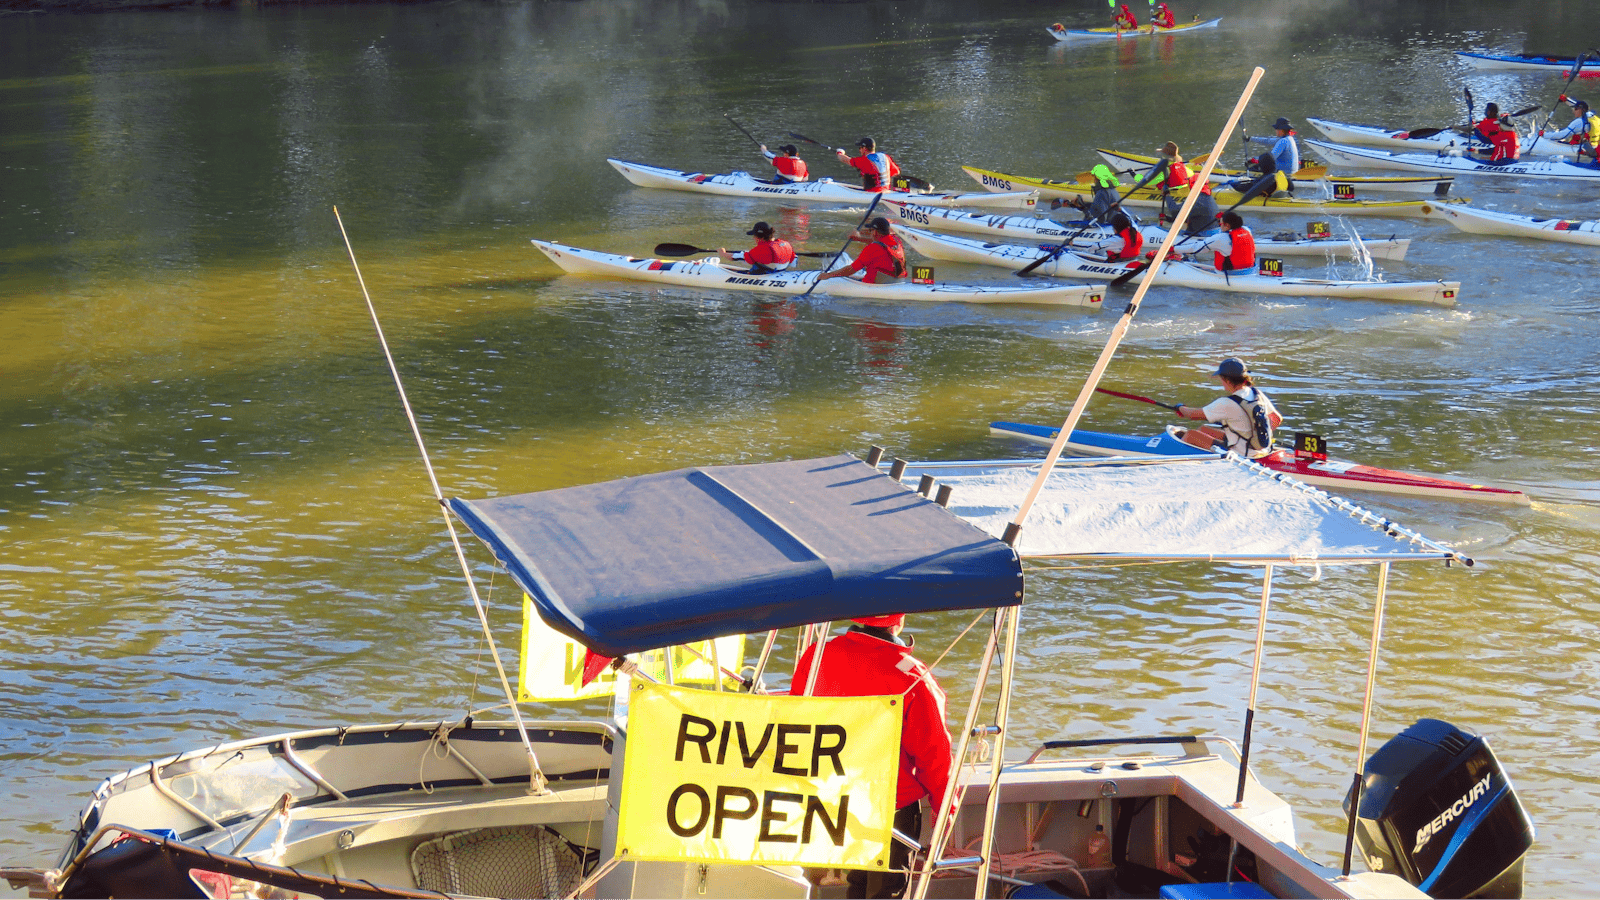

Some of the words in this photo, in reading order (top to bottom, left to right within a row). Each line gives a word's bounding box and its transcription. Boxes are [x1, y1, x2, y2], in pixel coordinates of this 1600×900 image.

[896, 179, 908, 188] 106
[982, 174, 1012, 191] BMGS
[752, 186, 784, 194] MIRAGE
[1337, 185, 1350, 195] 111
[899, 206, 930, 226] BMGS
[1036, 227, 1059, 236] GREGG
[1313, 223, 1324, 233] 25
[1149, 236, 1166, 244] BIL
[1076, 264, 1119, 275] MIRAGE
[1264, 259, 1279, 271] 110
[916, 268, 930, 279] 107
[725, 275, 767, 287] MIRAGE
[768, 279, 788, 288] 730
[1304, 436, 1318, 453] 53
[674, 713, 848, 778] RIVER
[666, 782, 850, 847] OPEN
[1411, 772, 1491, 854] MERCURY
